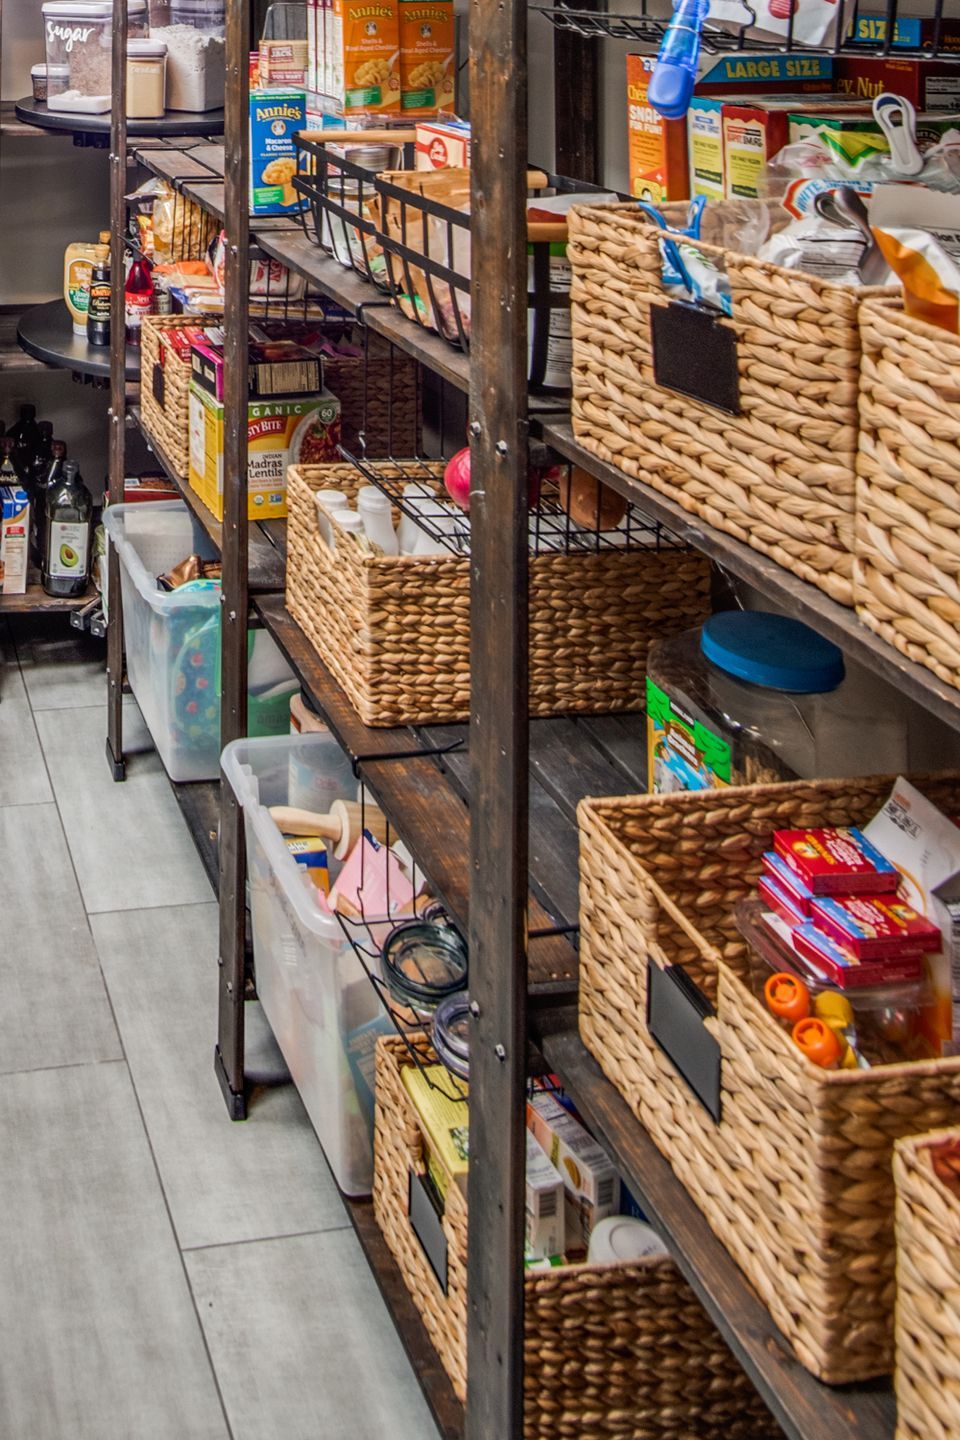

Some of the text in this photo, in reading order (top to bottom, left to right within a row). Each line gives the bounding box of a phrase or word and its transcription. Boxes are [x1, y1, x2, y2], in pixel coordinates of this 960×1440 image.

[349, 3, 393, 20] Annie's
[725, 59, 821, 79] LARGE SIZE
[857, 77, 885, 98] Nut
[255, 103, 302, 122] Annie's
[629, 105, 662, 124] SNAP
[630, 121, 644, 131] FOR
[265, 138, 292, 146] Macaron
[796, 180, 822, 212] WHITE
[252, 405, 302, 417] GANIC
[321, 408, 333, 417] 60
[247, 420, 283, 437] STY BITE
[247, 459, 283, 469] Madras
[248, 468, 284, 479] Lentils
